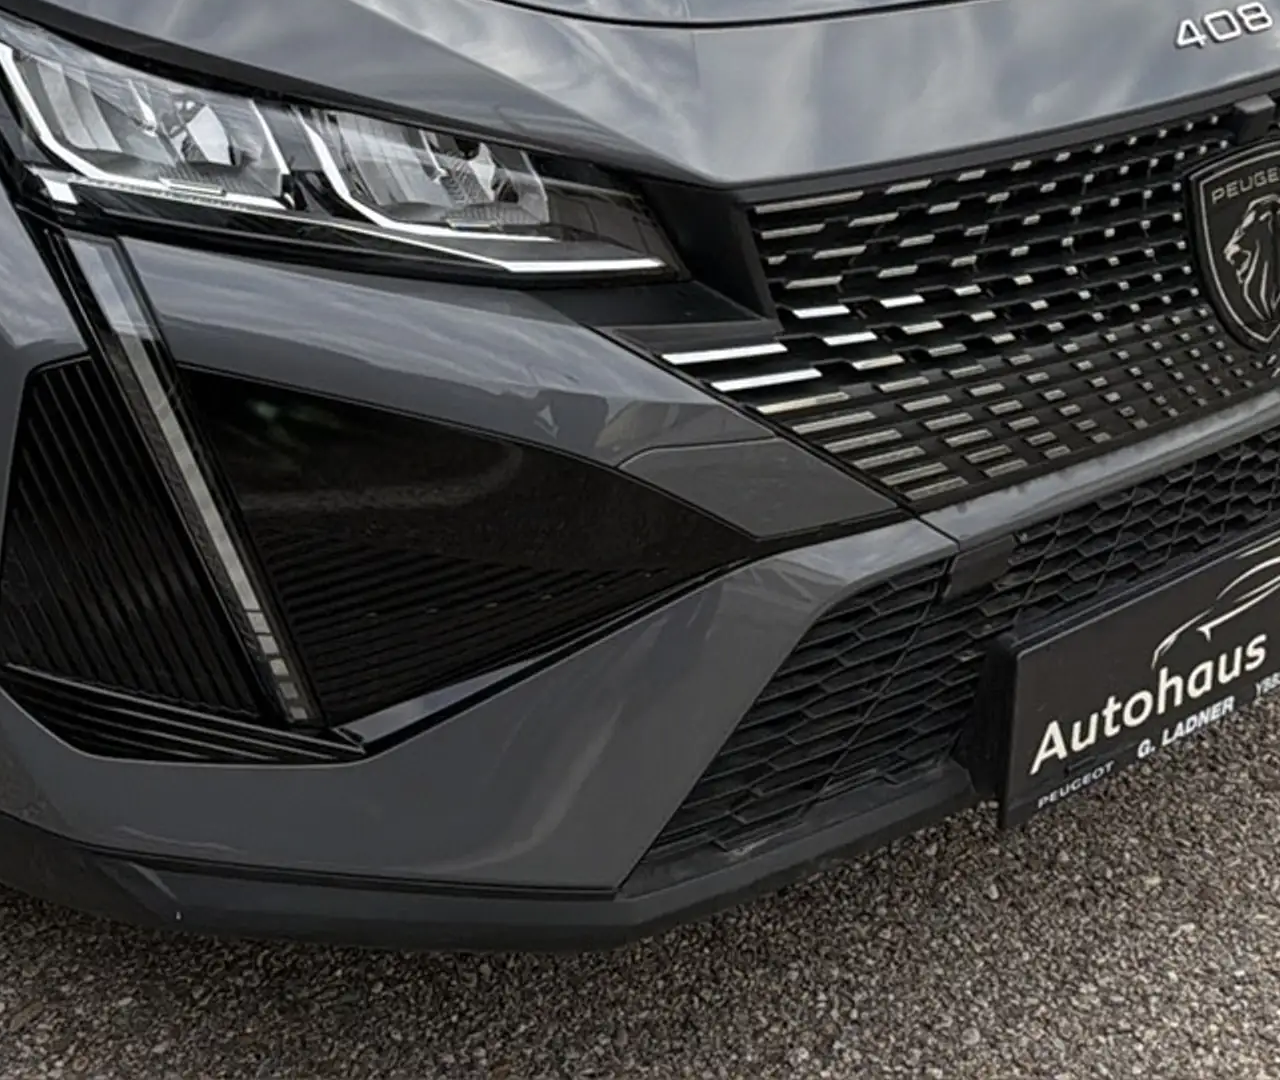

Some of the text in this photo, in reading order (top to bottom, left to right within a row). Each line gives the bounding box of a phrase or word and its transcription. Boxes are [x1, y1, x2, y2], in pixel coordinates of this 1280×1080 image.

[1176, 1, 1273, 47] 408
[1029, 633, 1267, 775] Autohaus
[1037, 760, 1115, 809] PEUGEOT
[1137, 737, 1157, 759] G.
[1161, 695, 1235, 747] LADNER
